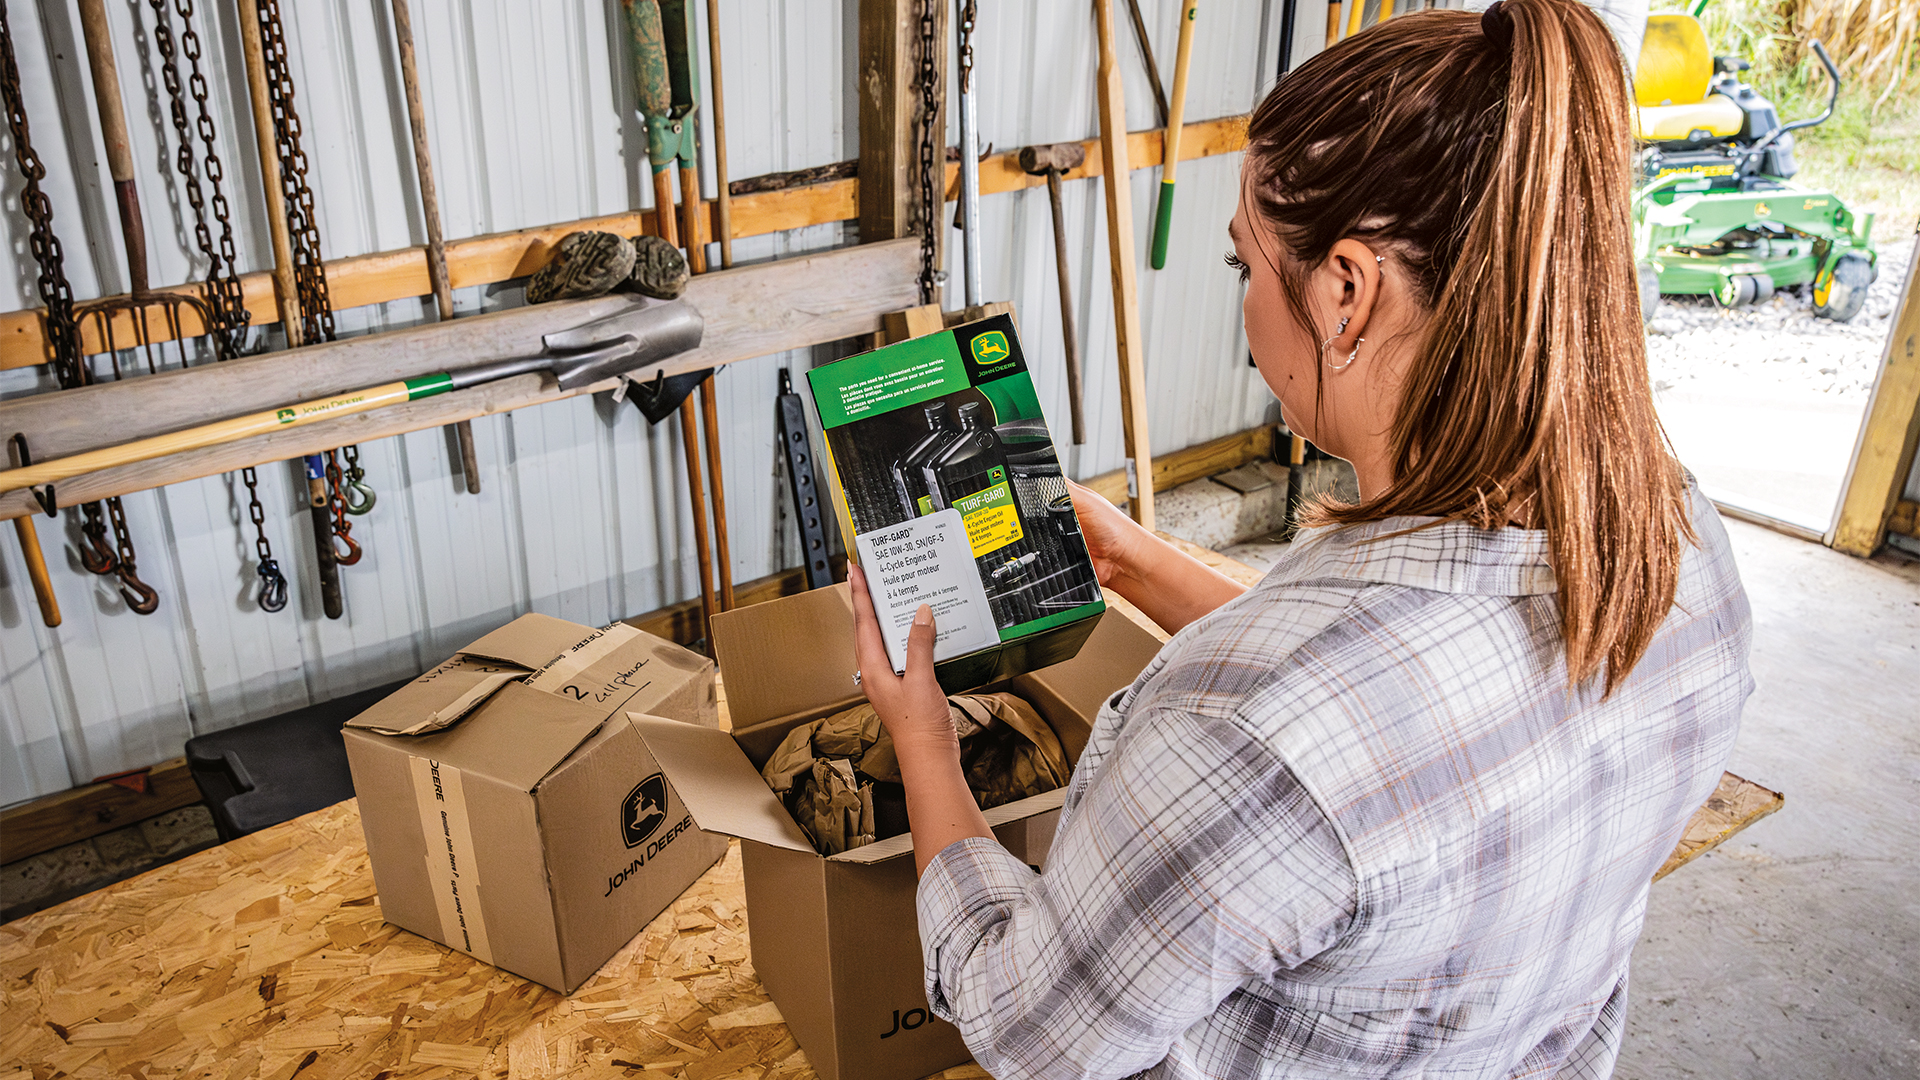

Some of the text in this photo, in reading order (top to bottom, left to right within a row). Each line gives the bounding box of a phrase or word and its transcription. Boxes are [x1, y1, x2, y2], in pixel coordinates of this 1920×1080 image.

[888, 368, 911, 378] convenient
[978, 362, 1016, 378] JOHN DEERE
[961, 487, 1005, 512] TURF-GARD
[875, 533, 944, 560] SAE 10W-30, SN/GF-5
[880, 549, 938, 573] 4-Cycle Engine Oil
[882, 564, 940, 586] Huile pour moteur
[886, 584, 919, 599] à 4 temps
[904, 598, 914, 606] para
[914, 592, 932, 602] motores
[942, 585, 958, 594] tiempos
[544, 654, 566, 669] Genuine
[533, 669, 546, 680] John
[563, 685, 590, 700] 2
[430, 760, 444, 802] DEERE
[440, 810, 450, 836] Genuine
[449, 853, 457, 871] Deere
[605, 815, 692, 897] JOHN DEERE
[463, 929, 472, 952] Genuine
